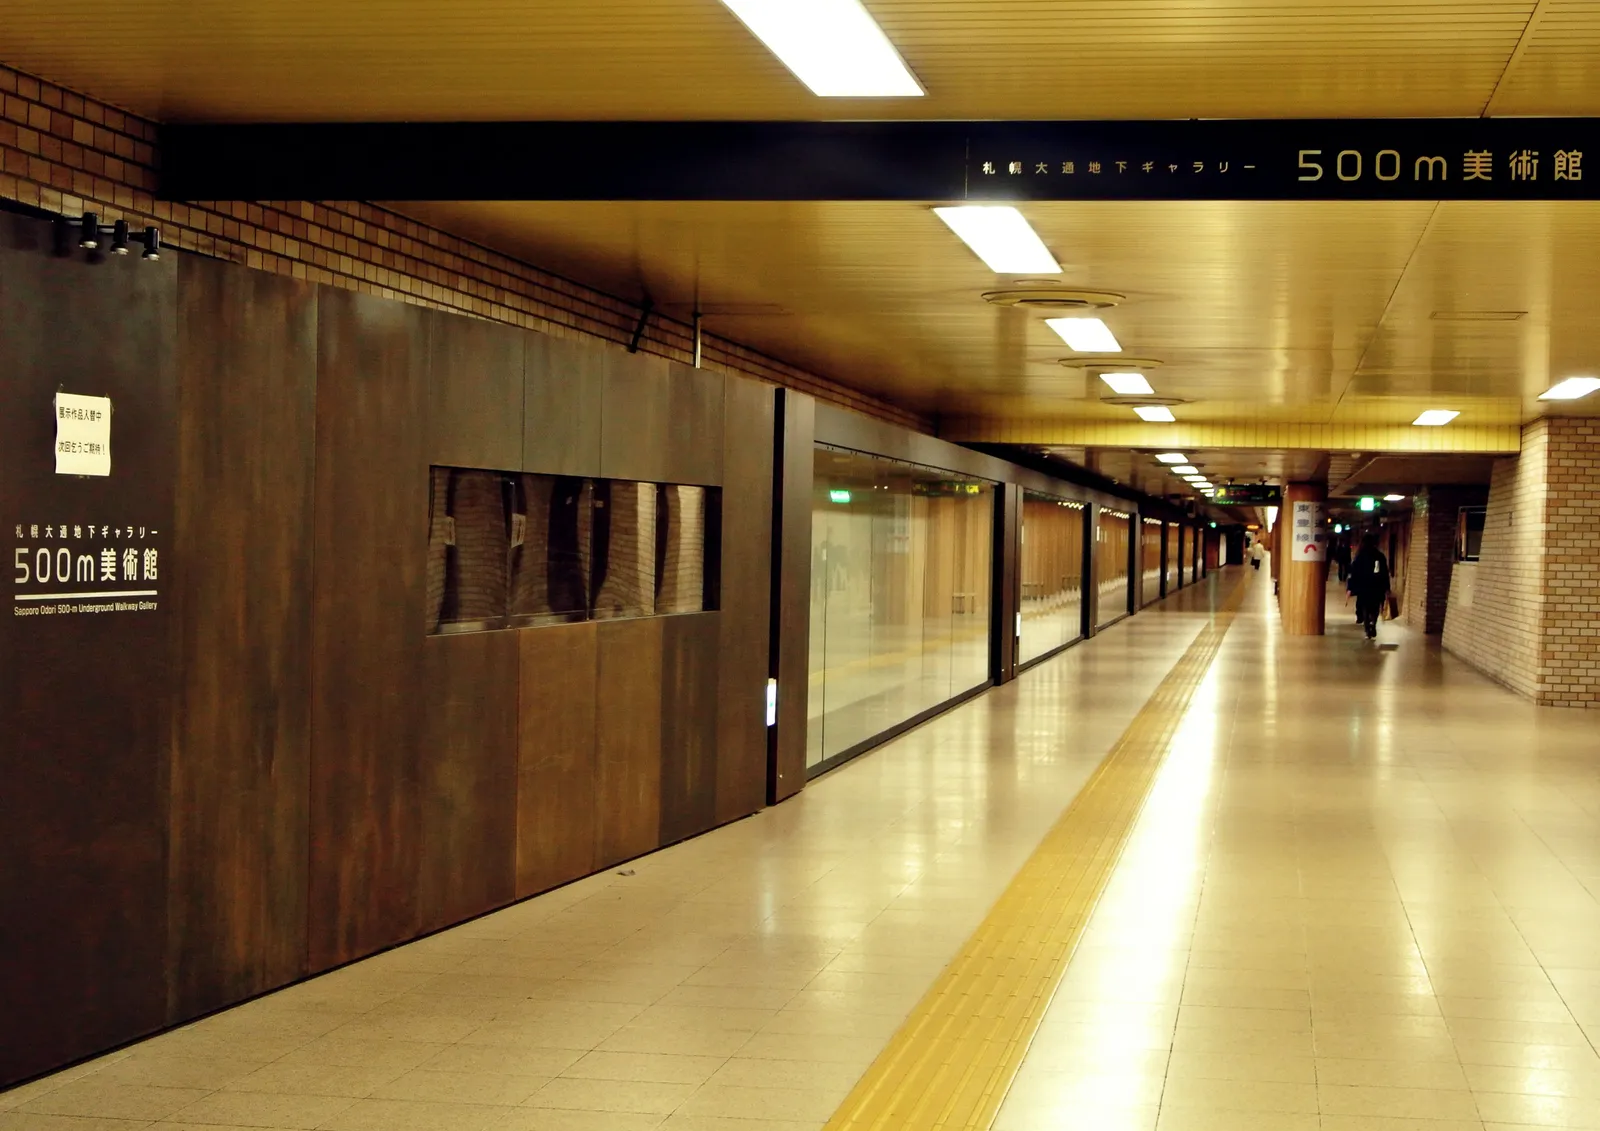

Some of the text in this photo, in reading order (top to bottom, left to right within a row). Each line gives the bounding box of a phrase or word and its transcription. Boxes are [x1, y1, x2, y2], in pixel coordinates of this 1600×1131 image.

[983, 161, 1256, 174] 札幌大通地下ギャラリー
[1298, 150, 1583, 181] 500m美術館
[15, 524, 158, 539] 札幌大通地下ギャラリー
[14, 547, 158, 584] 500m美術館
[14, 601, 158, 616] Sapporo Odori 500-m Underground Walkway Gallery
